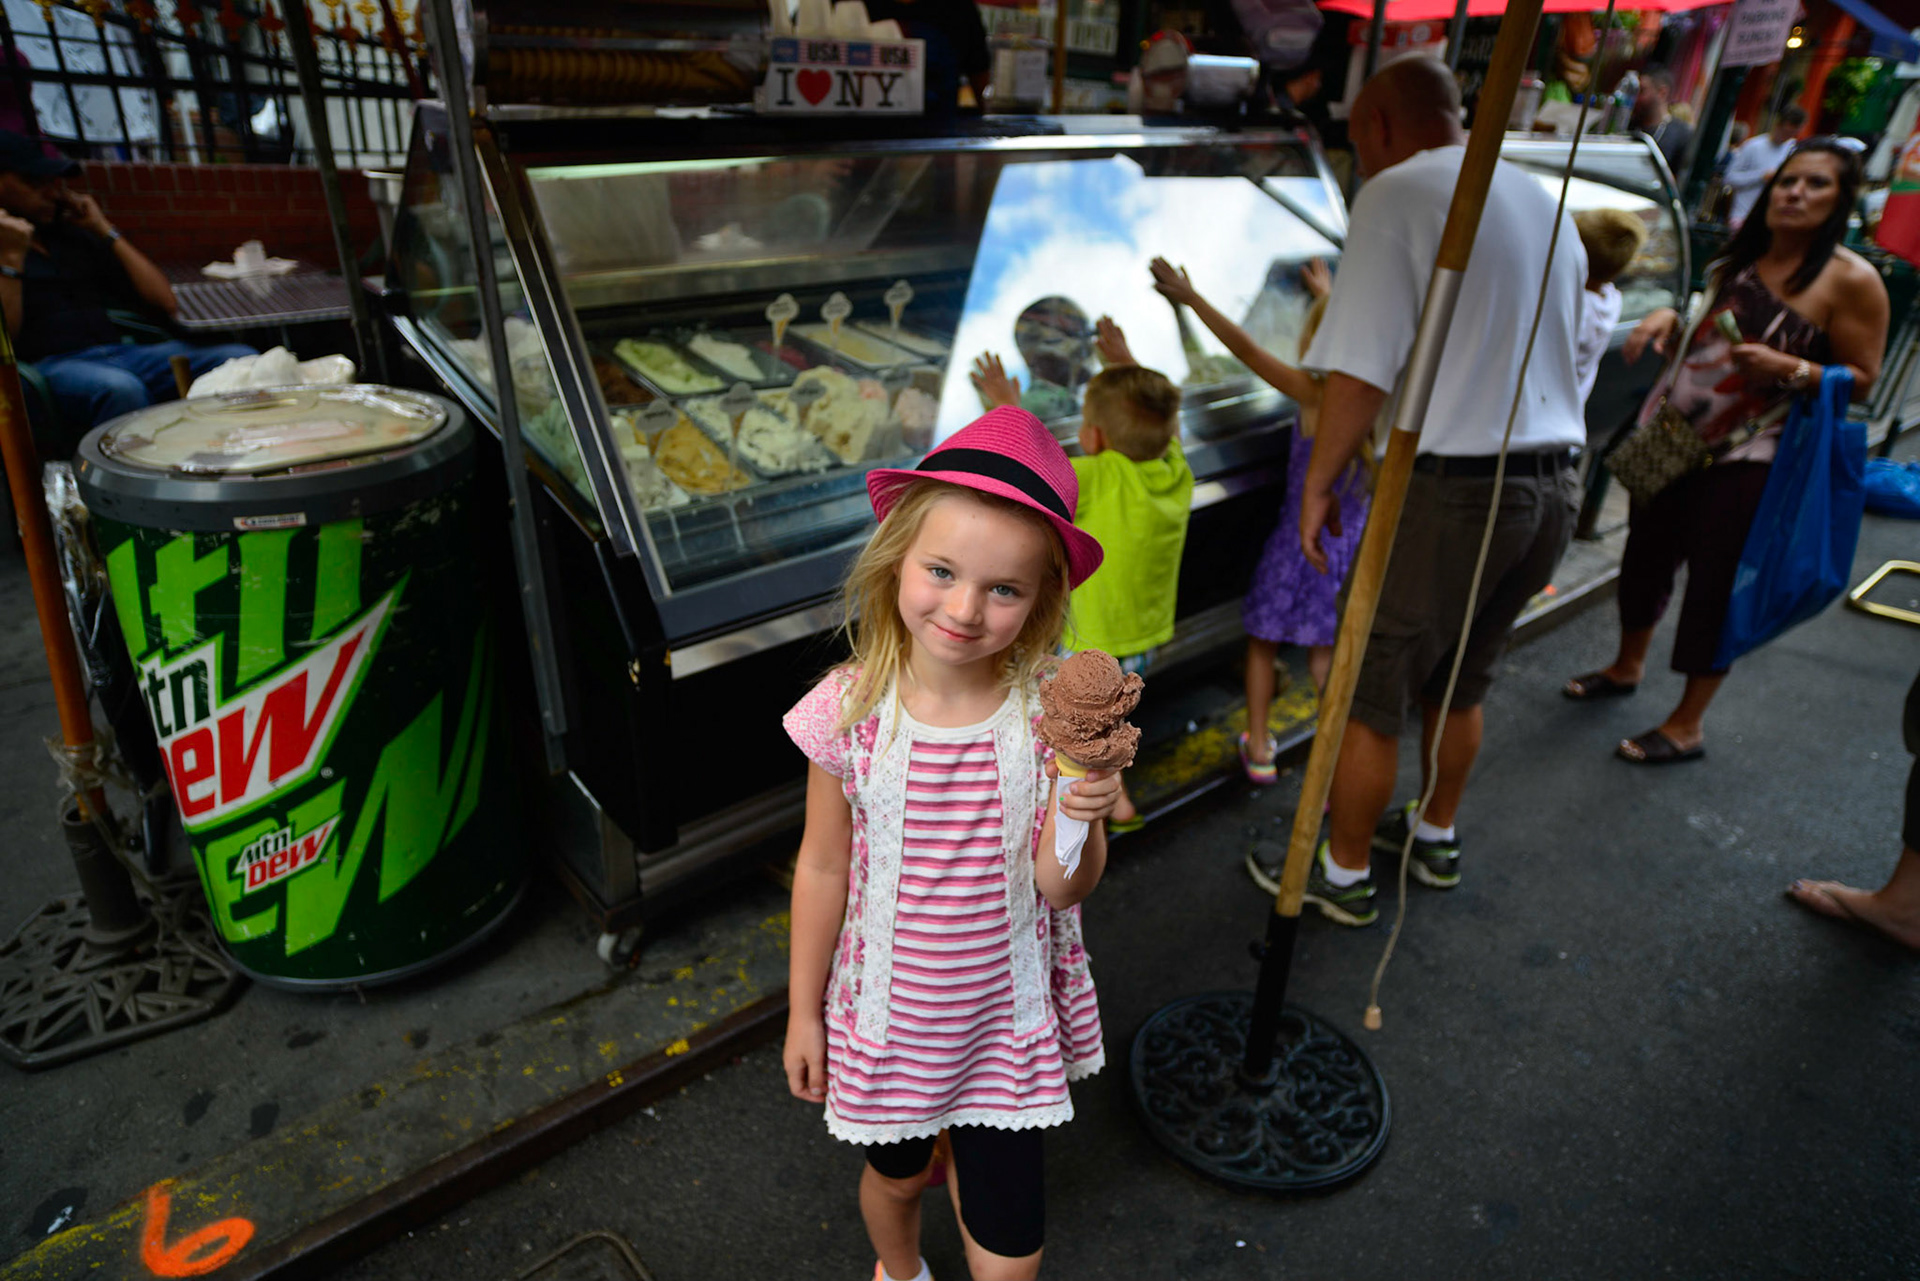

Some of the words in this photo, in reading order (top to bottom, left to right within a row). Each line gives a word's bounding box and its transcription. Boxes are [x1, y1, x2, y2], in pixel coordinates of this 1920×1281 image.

[776, 67, 795, 106] I
[834, 70, 903, 107] NY
[807, 42, 840, 62] USA
[880, 46, 910, 65] USA
[143, 658, 211, 740] tn
[160, 625, 368, 818] ew
[141, 1177, 256, 1278] 6
